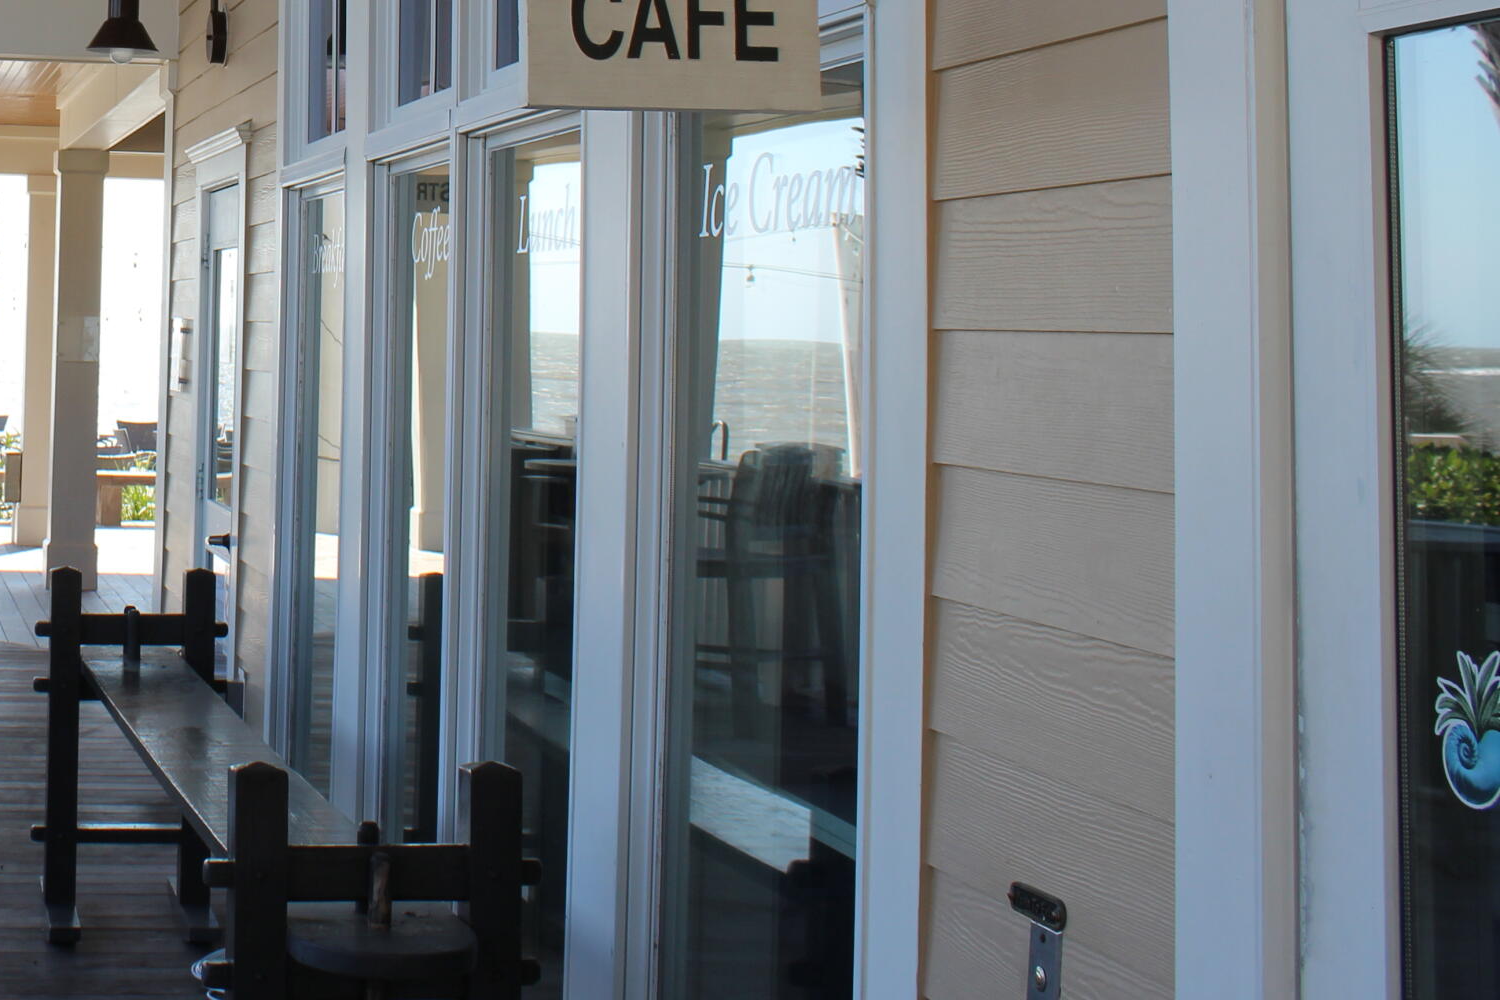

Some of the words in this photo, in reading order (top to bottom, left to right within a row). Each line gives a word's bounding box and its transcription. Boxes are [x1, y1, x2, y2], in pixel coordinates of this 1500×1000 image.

[517, 183, 575, 254] Lunch
[699, 163, 739, 238] Ice
[749, 152, 857, 233] Cream
[412, 206, 449, 280] Coffee
